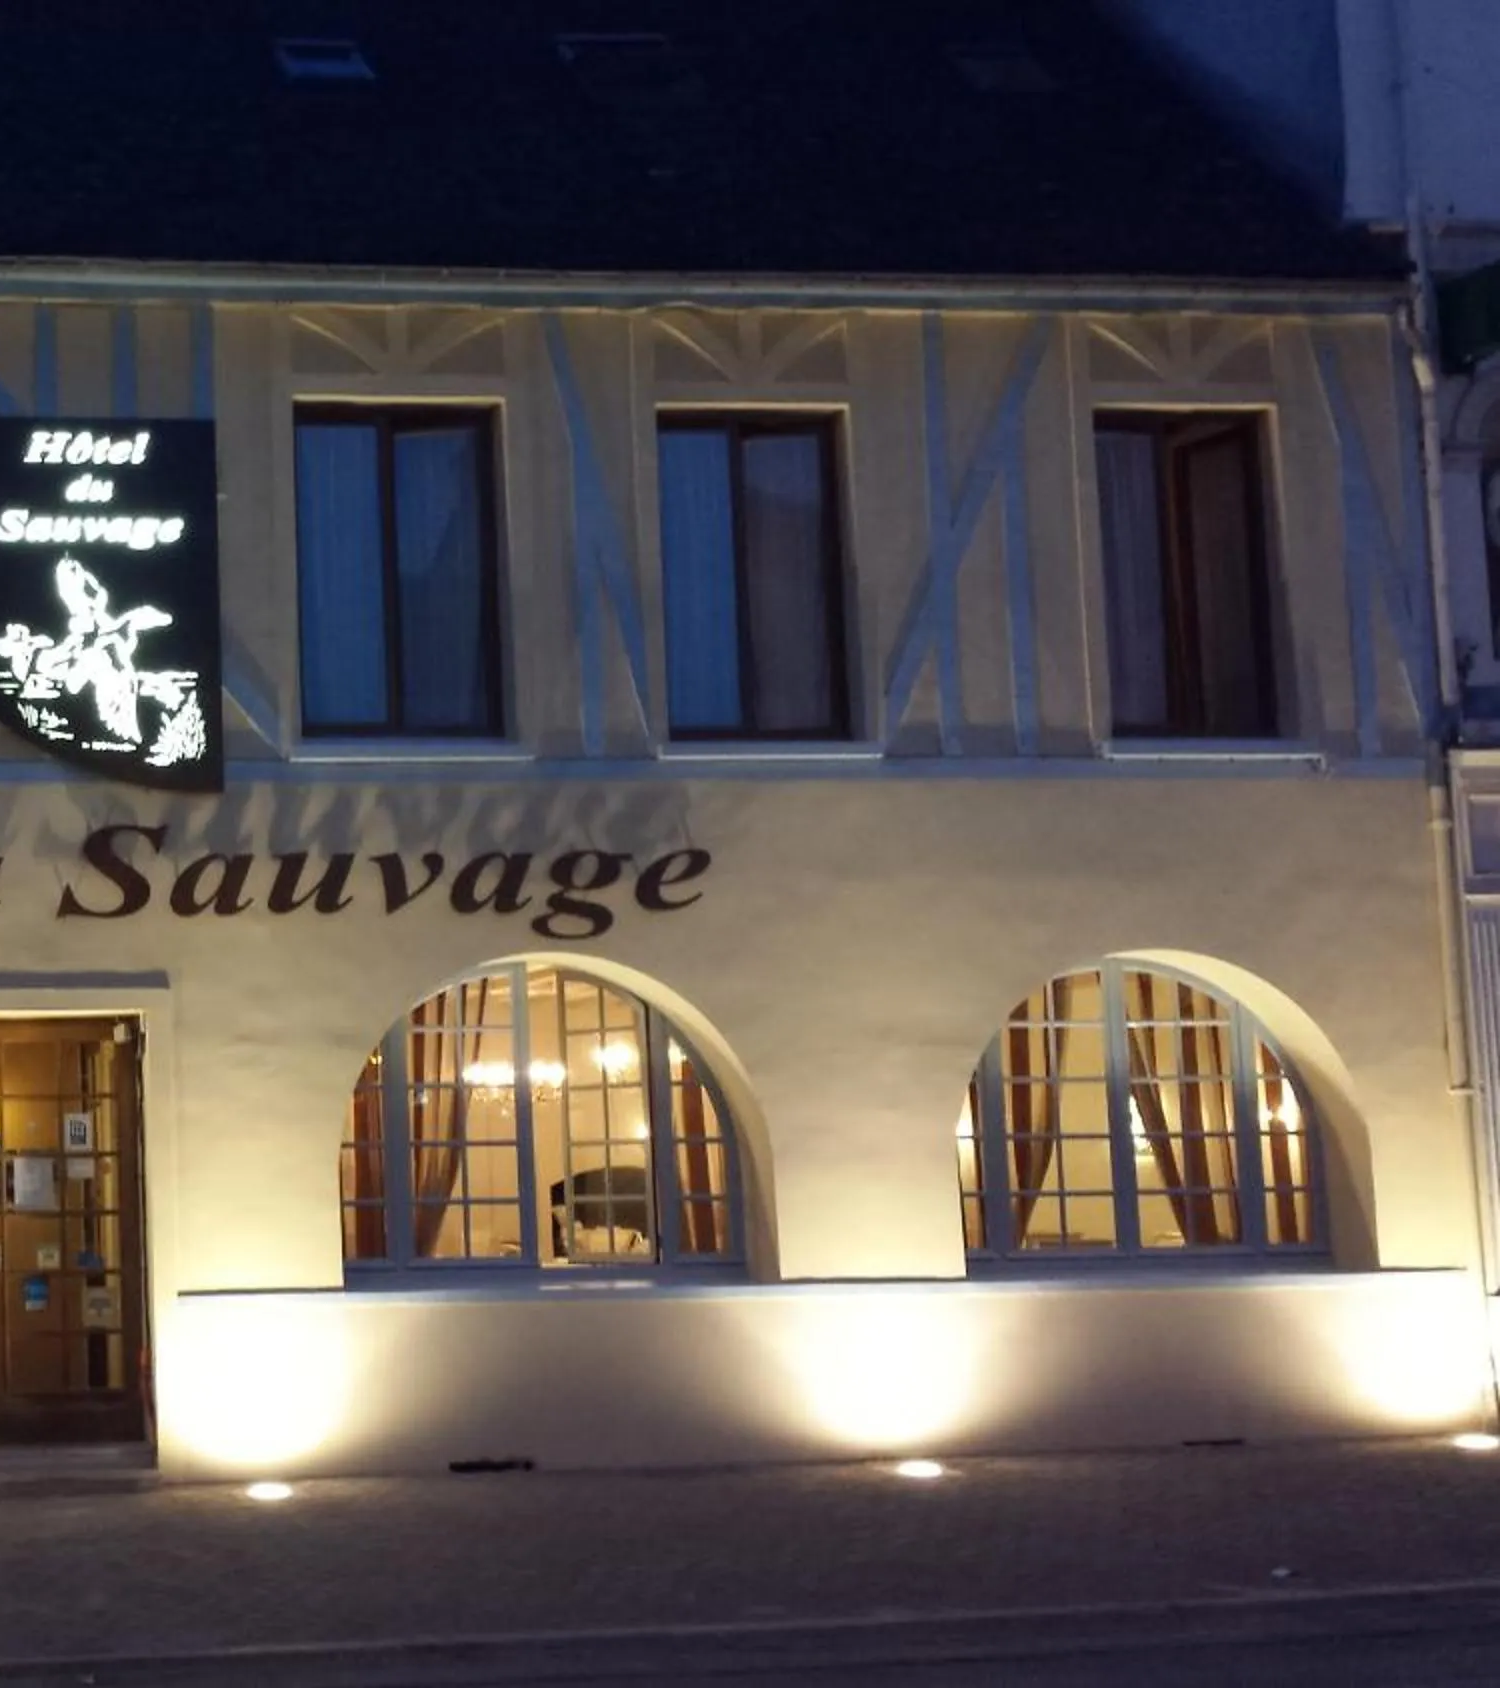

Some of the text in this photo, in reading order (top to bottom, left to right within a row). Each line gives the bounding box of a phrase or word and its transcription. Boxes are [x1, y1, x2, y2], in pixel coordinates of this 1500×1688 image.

[23, 430, 151, 465] Hôtel
[64, 472, 115, 503] du
[56, 823, 712, 940] Sauvage
